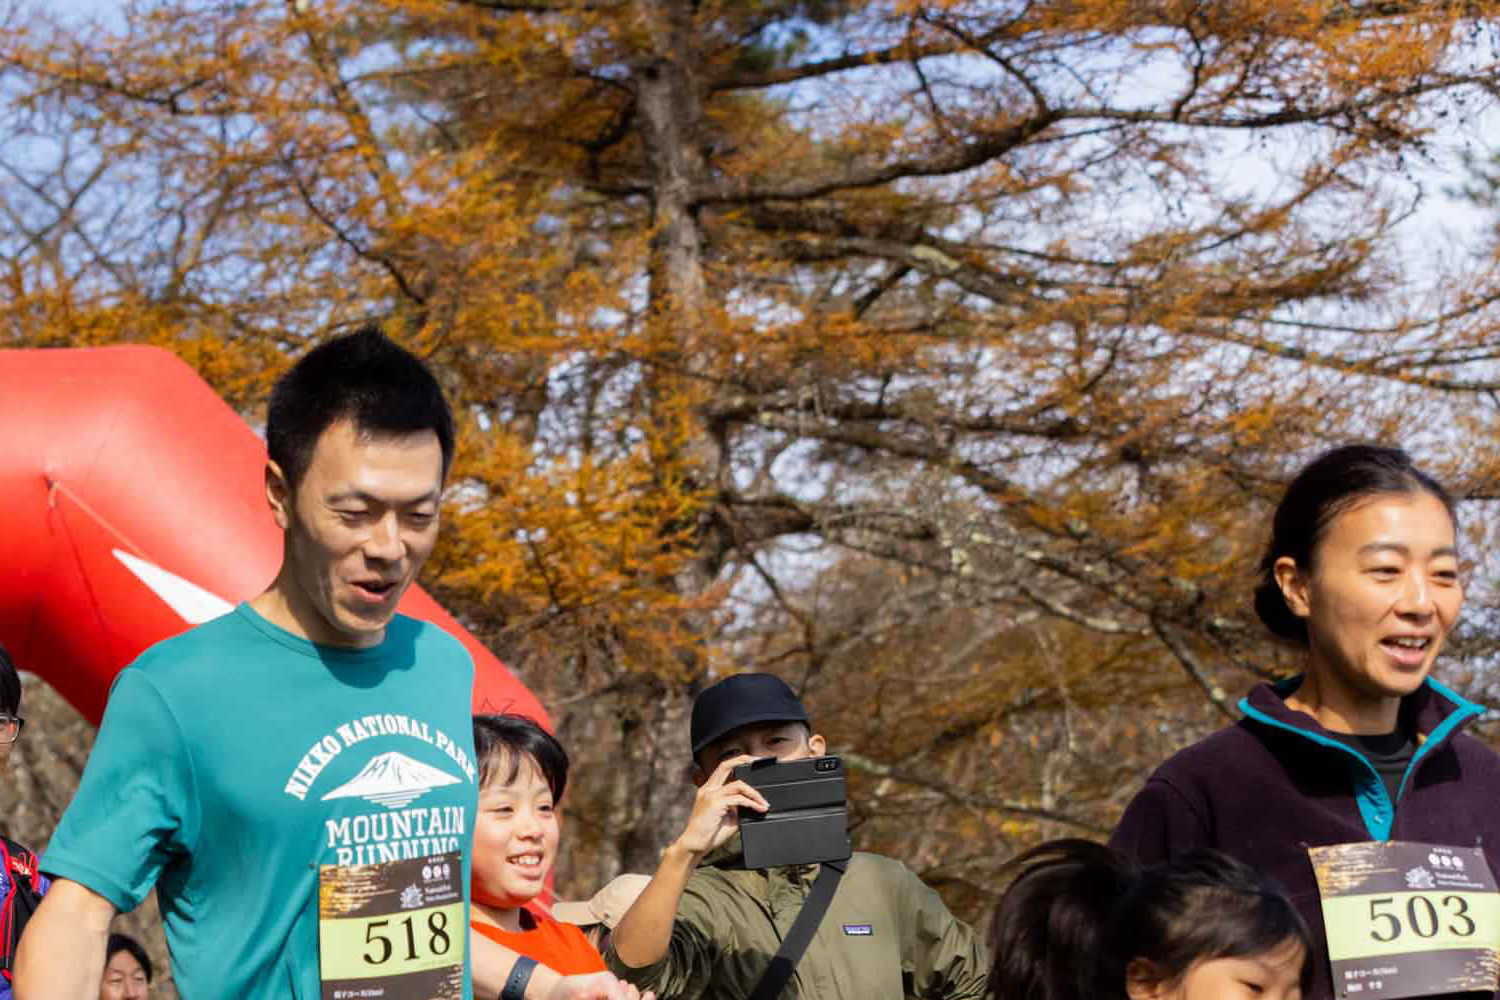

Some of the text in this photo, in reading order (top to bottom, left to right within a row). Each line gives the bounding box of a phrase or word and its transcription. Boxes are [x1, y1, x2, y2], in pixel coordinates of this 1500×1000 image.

[284, 714, 476, 800] NIKKO NATIONAL PARK
[325, 807, 465, 848] MOUNTAIN
[363, 911, 451, 965] 518
[1369, 895, 1476, 942] 503
